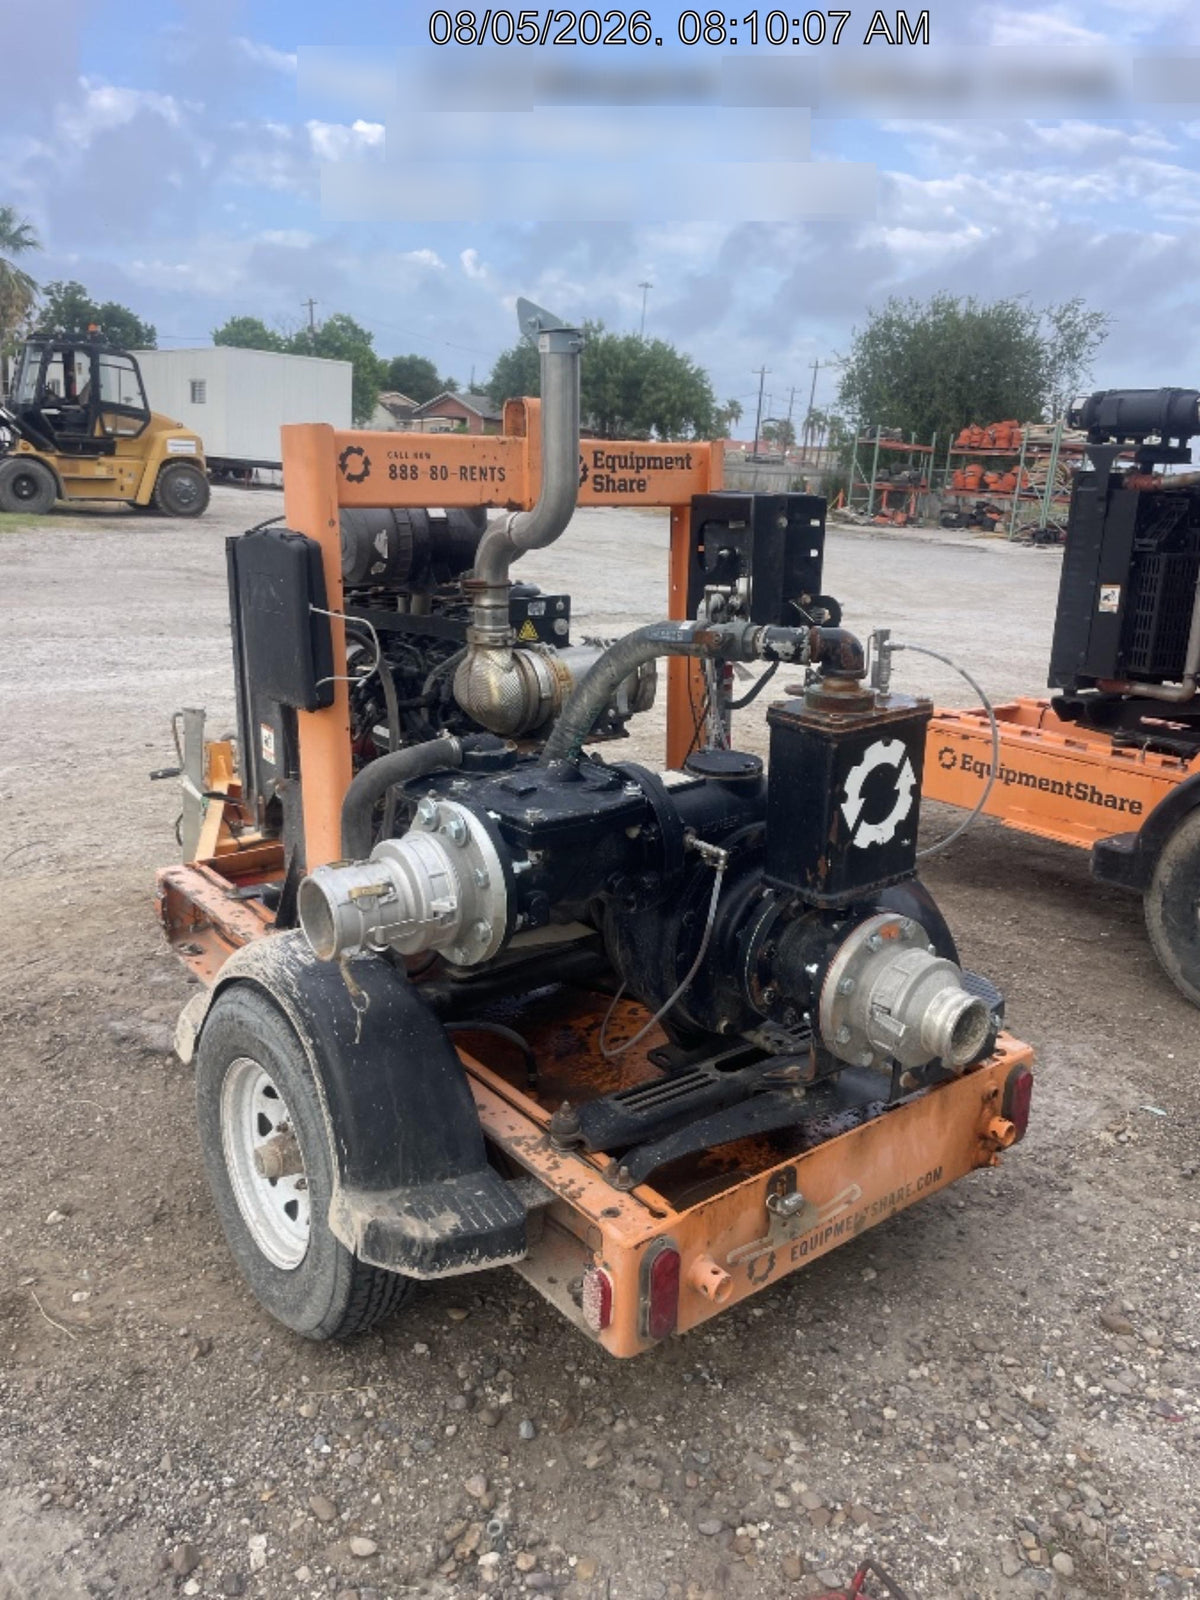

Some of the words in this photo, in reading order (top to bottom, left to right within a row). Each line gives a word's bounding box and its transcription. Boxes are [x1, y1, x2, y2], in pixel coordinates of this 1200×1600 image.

[387, 451, 408, 460] CALL
[592, 450, 692, 473] Equipment
[592, 474, 647, 493] Share
